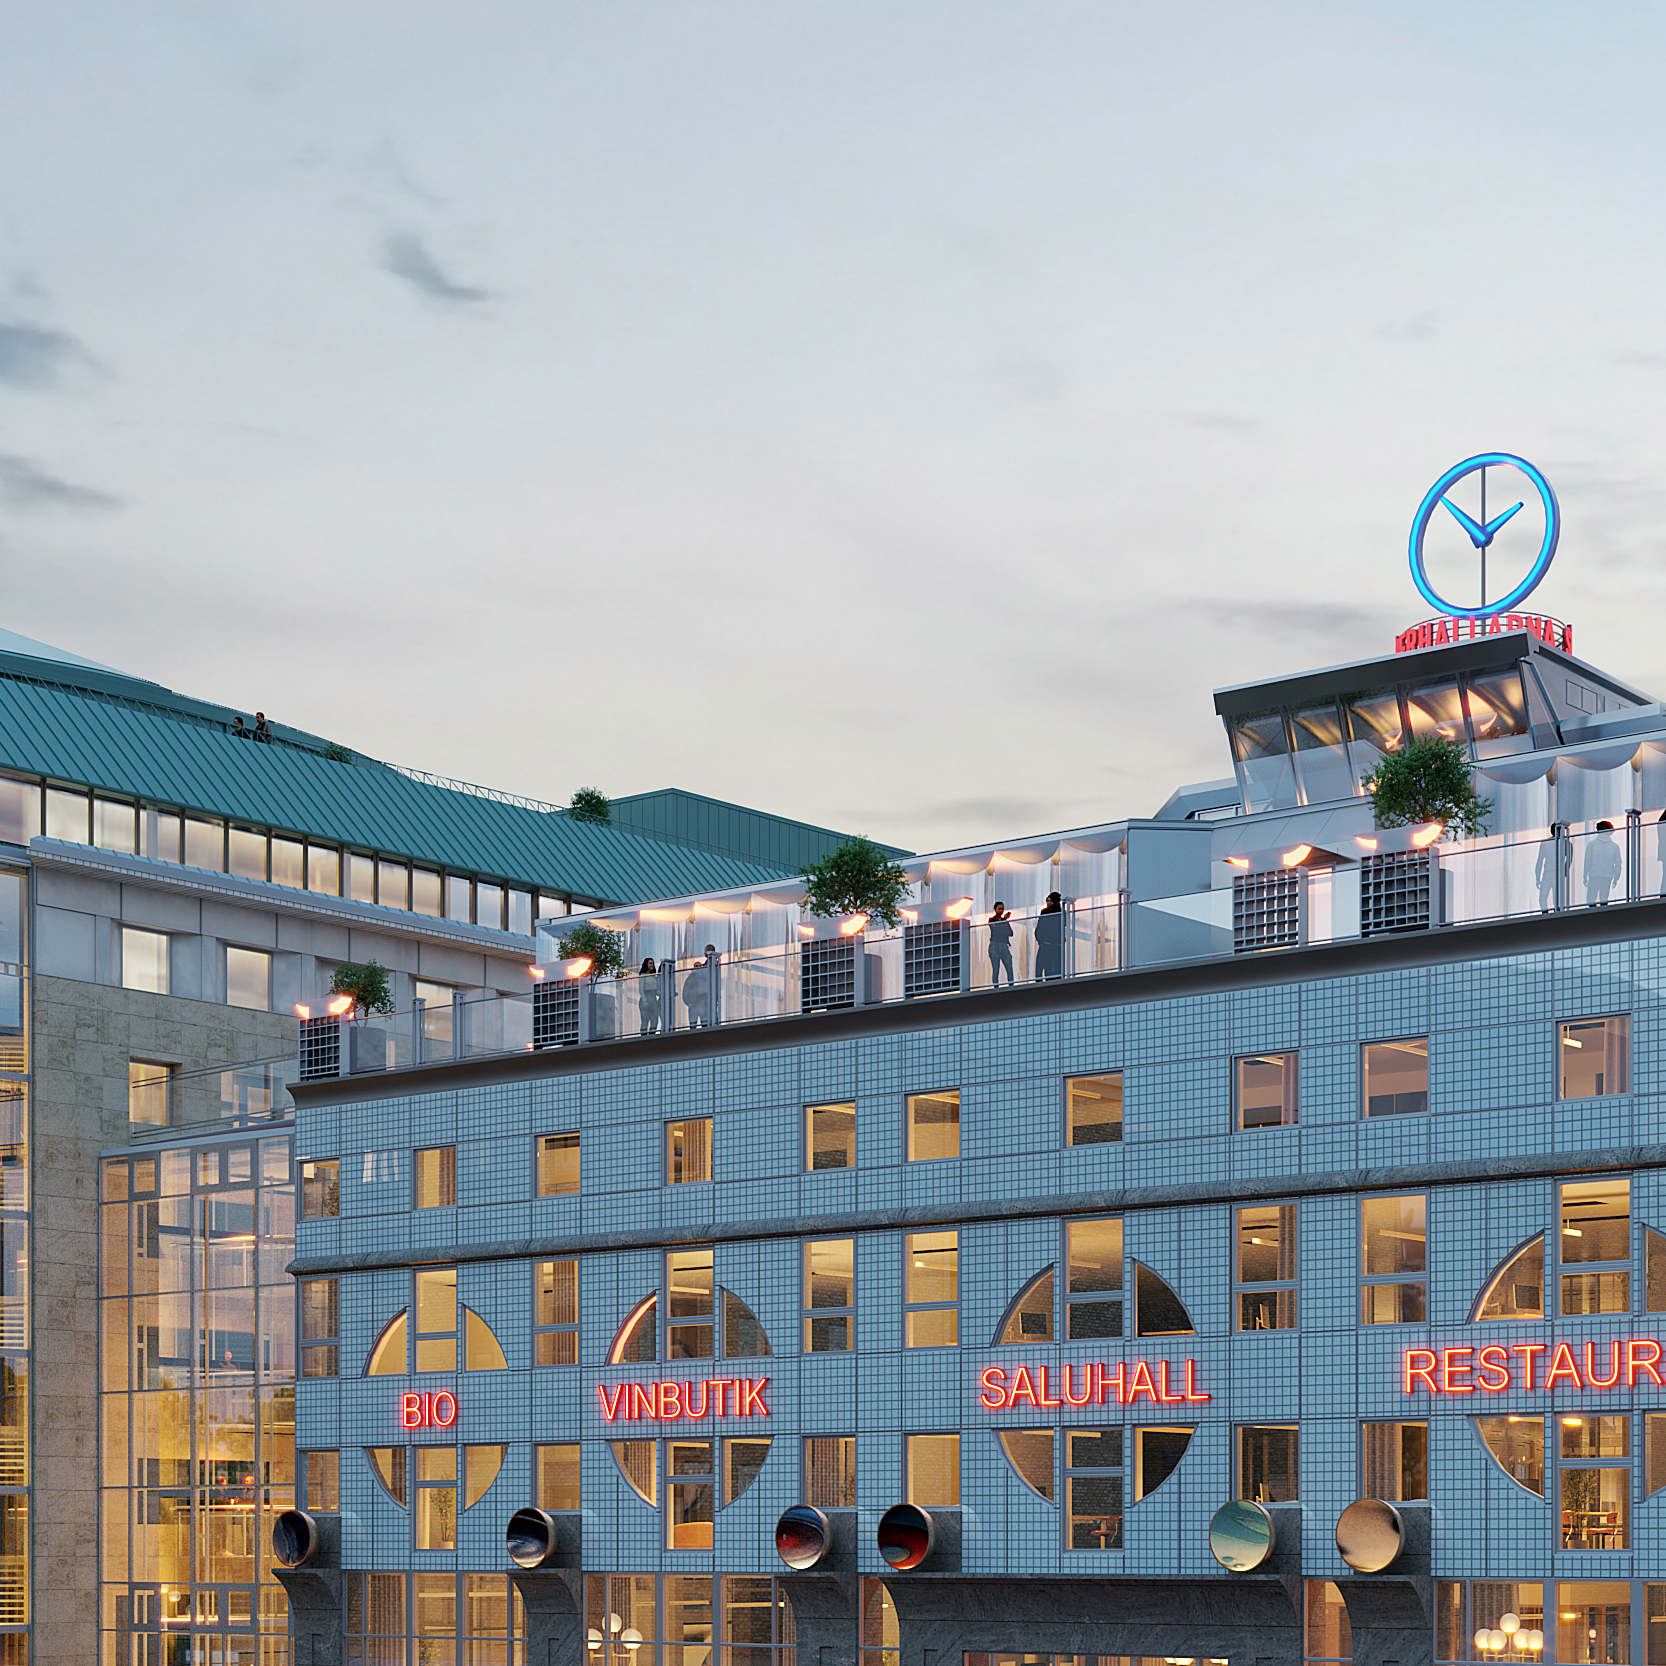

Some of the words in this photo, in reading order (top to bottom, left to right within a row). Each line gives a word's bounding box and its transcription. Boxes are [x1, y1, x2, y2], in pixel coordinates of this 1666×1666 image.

[598, 1376, 773, 1421] VINBUTIK
[980, 1357, 1212, 1409] SALUHALL
[401, 1390, 459, 1429] BIO
